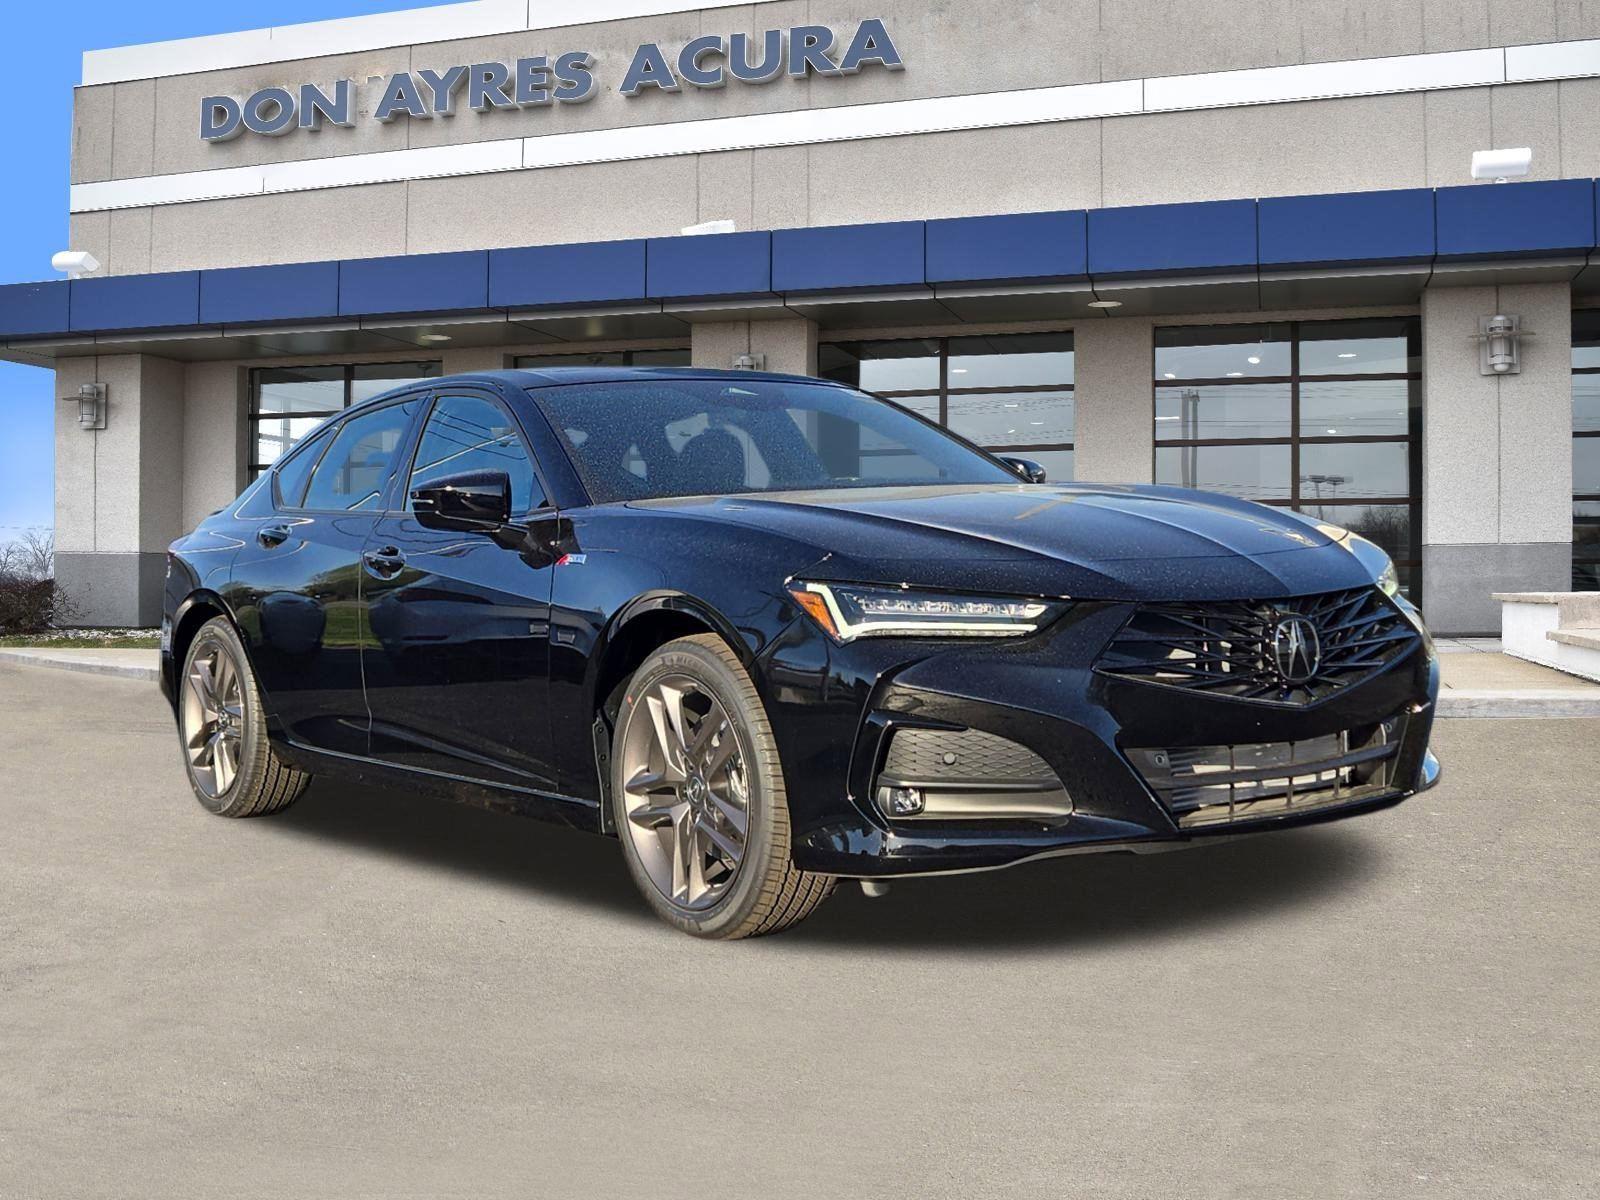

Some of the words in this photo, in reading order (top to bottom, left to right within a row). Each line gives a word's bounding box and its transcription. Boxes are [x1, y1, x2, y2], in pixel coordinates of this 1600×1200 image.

[200, 79, 354, 142] DON
[374, 51, 597, 122] AYRES
[618, 17, 904, 97] ACURA
